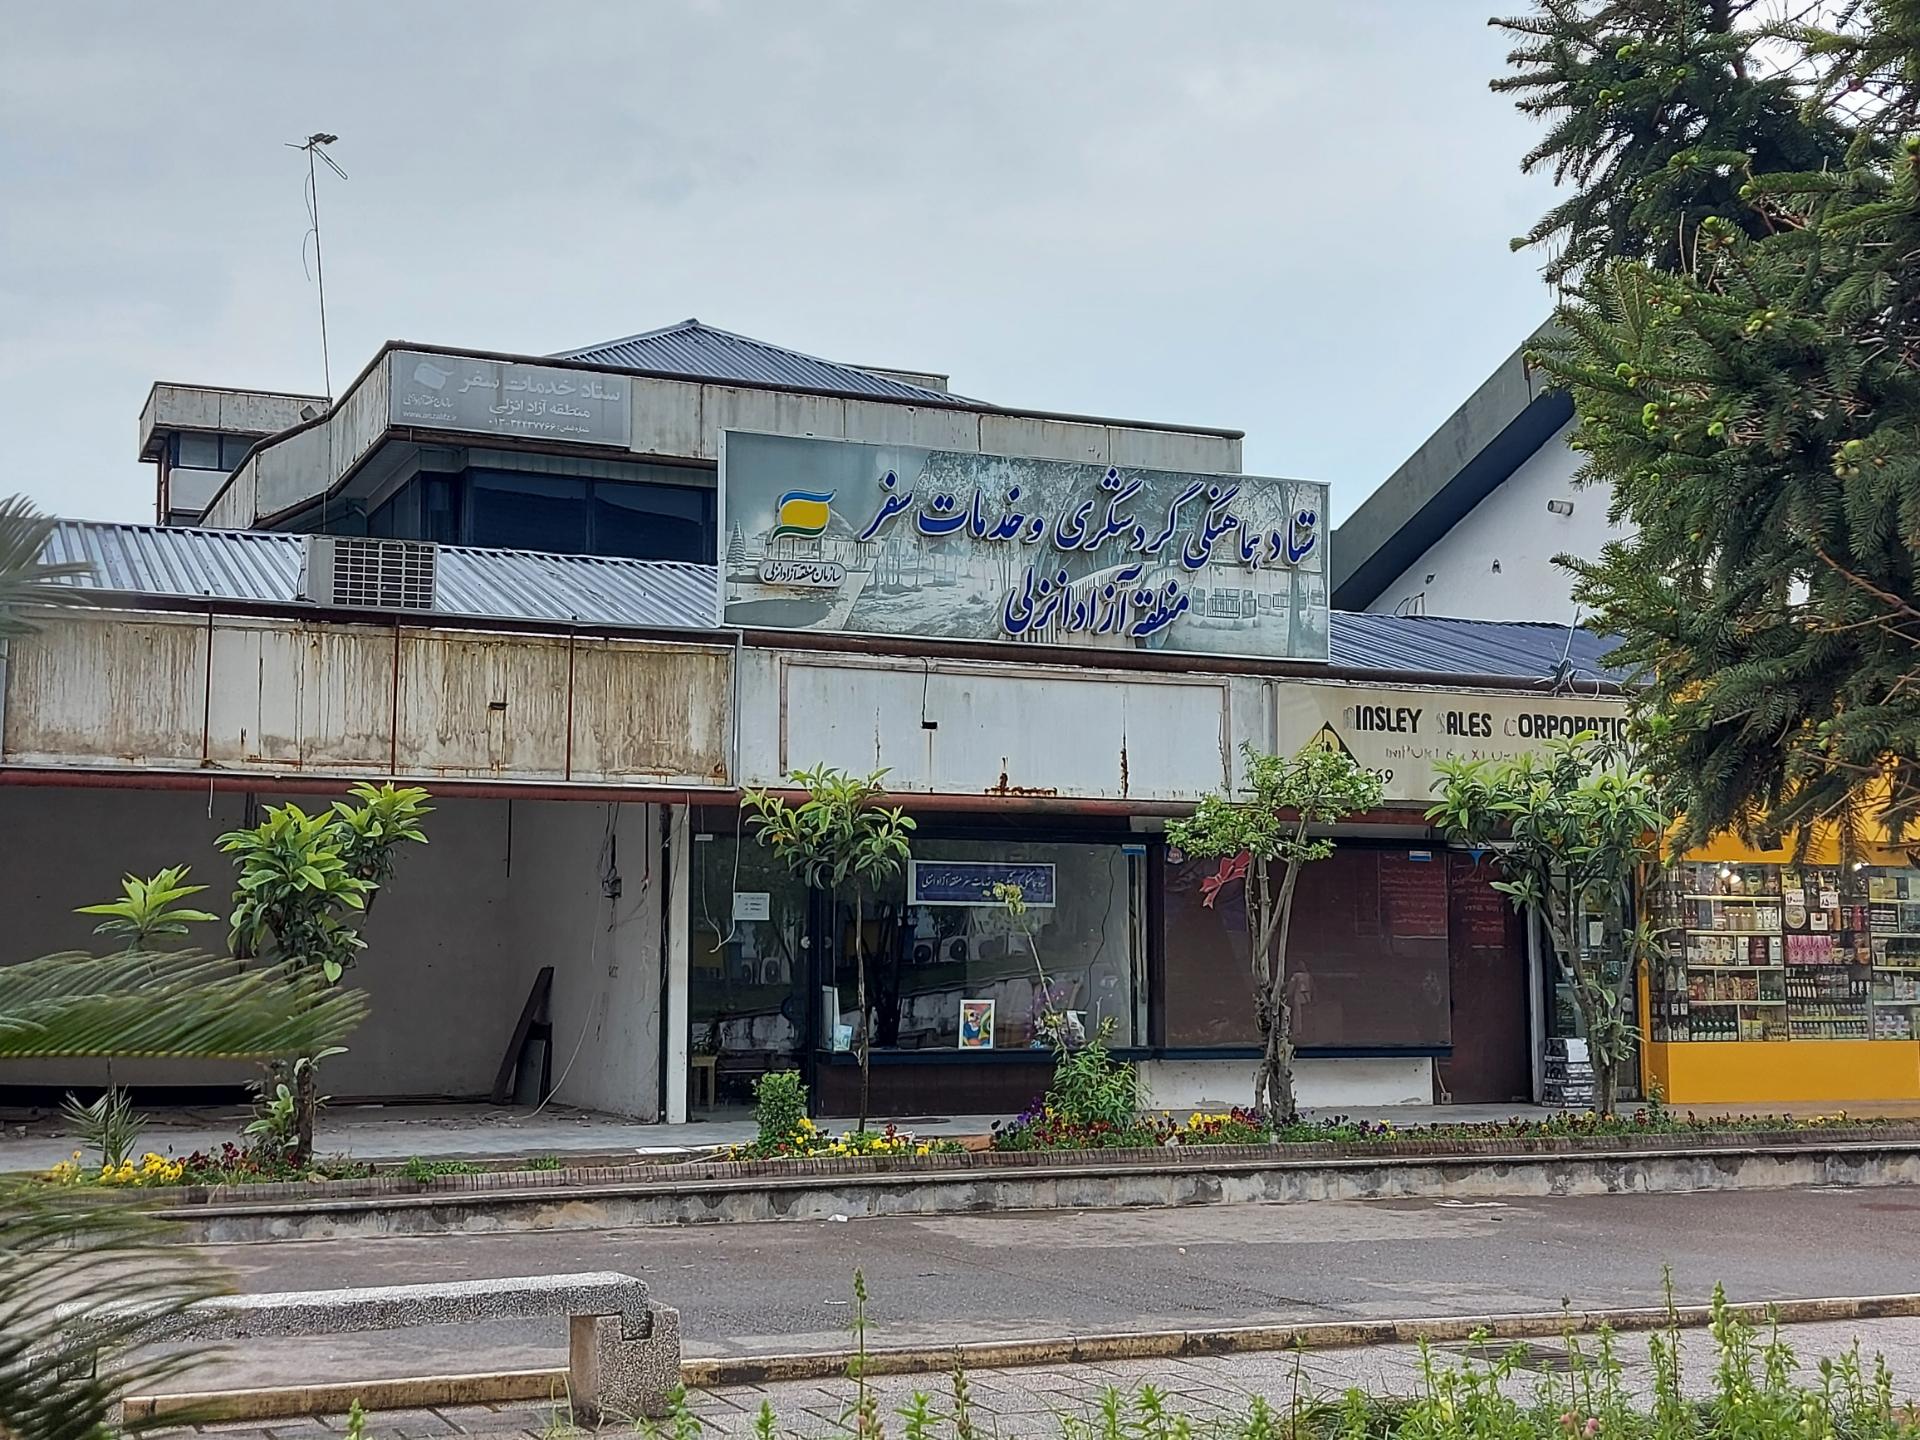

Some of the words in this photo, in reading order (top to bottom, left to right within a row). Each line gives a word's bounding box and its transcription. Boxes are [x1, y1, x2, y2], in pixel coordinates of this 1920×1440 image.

[458, 370, 500, 393] سفر
[505, 375, 576, 396] خدمات
[580, 381, 620, 401] ستاد
[487, 398, 524, 415] انزلی
[527, 399, 547, 416] آزاد
[549, 402, 591, 418] منطقه
[860, 469, 914, 541] سفر
[917, 484, 1025, 541] خدمات
[1054, 466, 1206, 552] گردشگری
[1026, 516, 1045, 544] و
[1181, 484, 1262, 571] هماهنگی
[1269, 510, 1317, 566] ستاد
[763, 562, 784, 582] انزلی
[794, 564, 818, 581] منطقه
[811, 565, 842, 584] سازمان
[1003, 564, 1074, 636] انزلی
[1071, 562, 1144, 635] آزاد
[1130, 579, 1191, 637] منطقه
